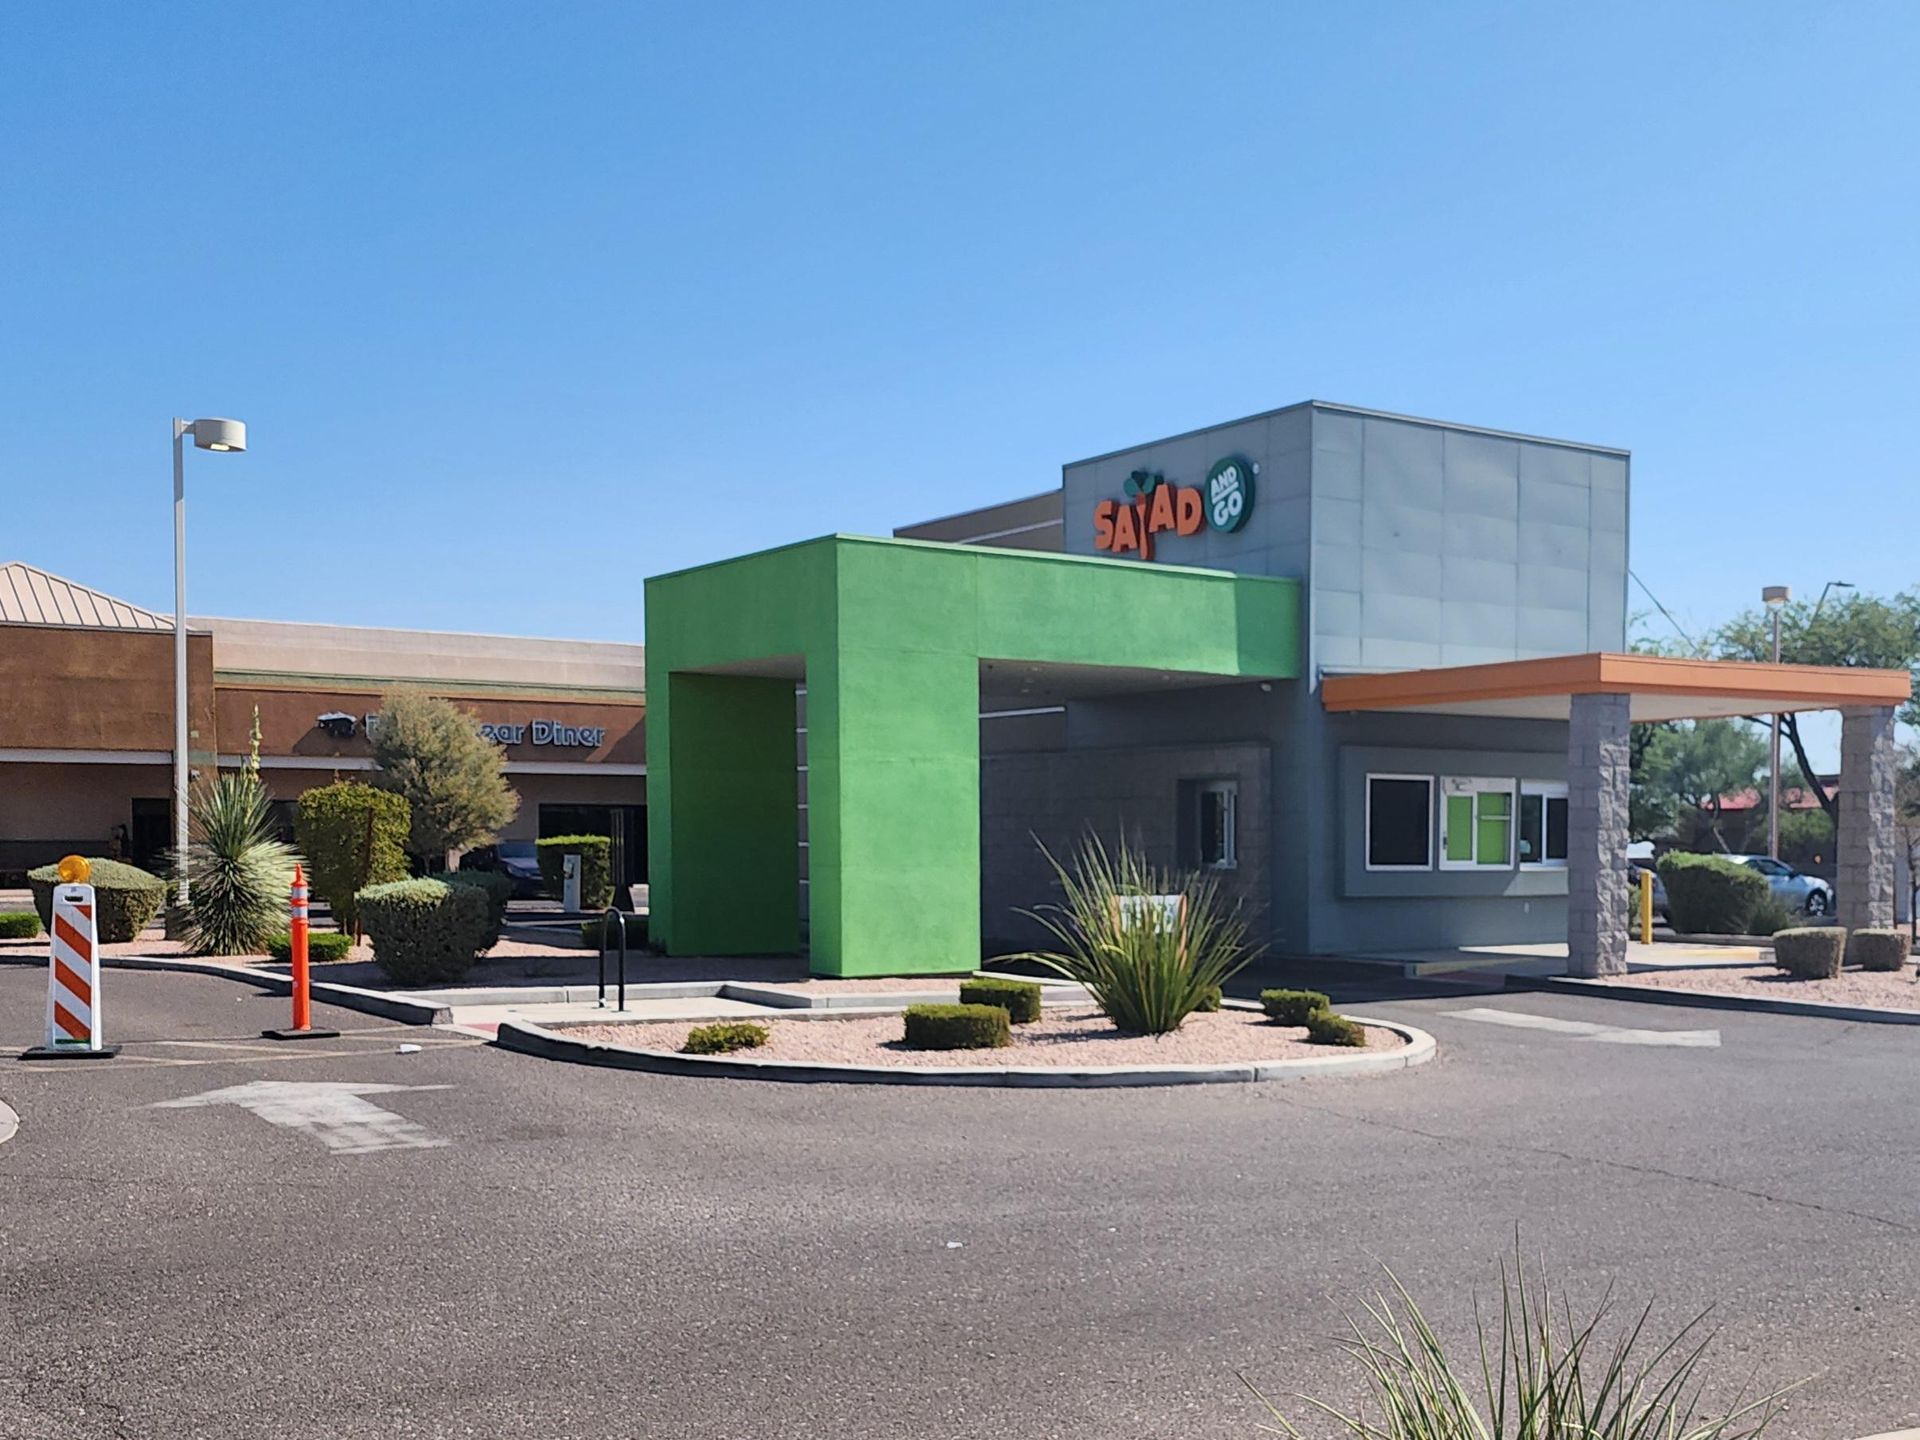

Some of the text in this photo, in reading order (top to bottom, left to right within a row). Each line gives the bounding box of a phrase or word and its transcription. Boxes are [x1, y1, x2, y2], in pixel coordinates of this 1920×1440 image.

[1211, 465, 1237, 498] AND
[1213, 491, 1243, 526] GO
[461, 719, 606, 747] ear Diner
